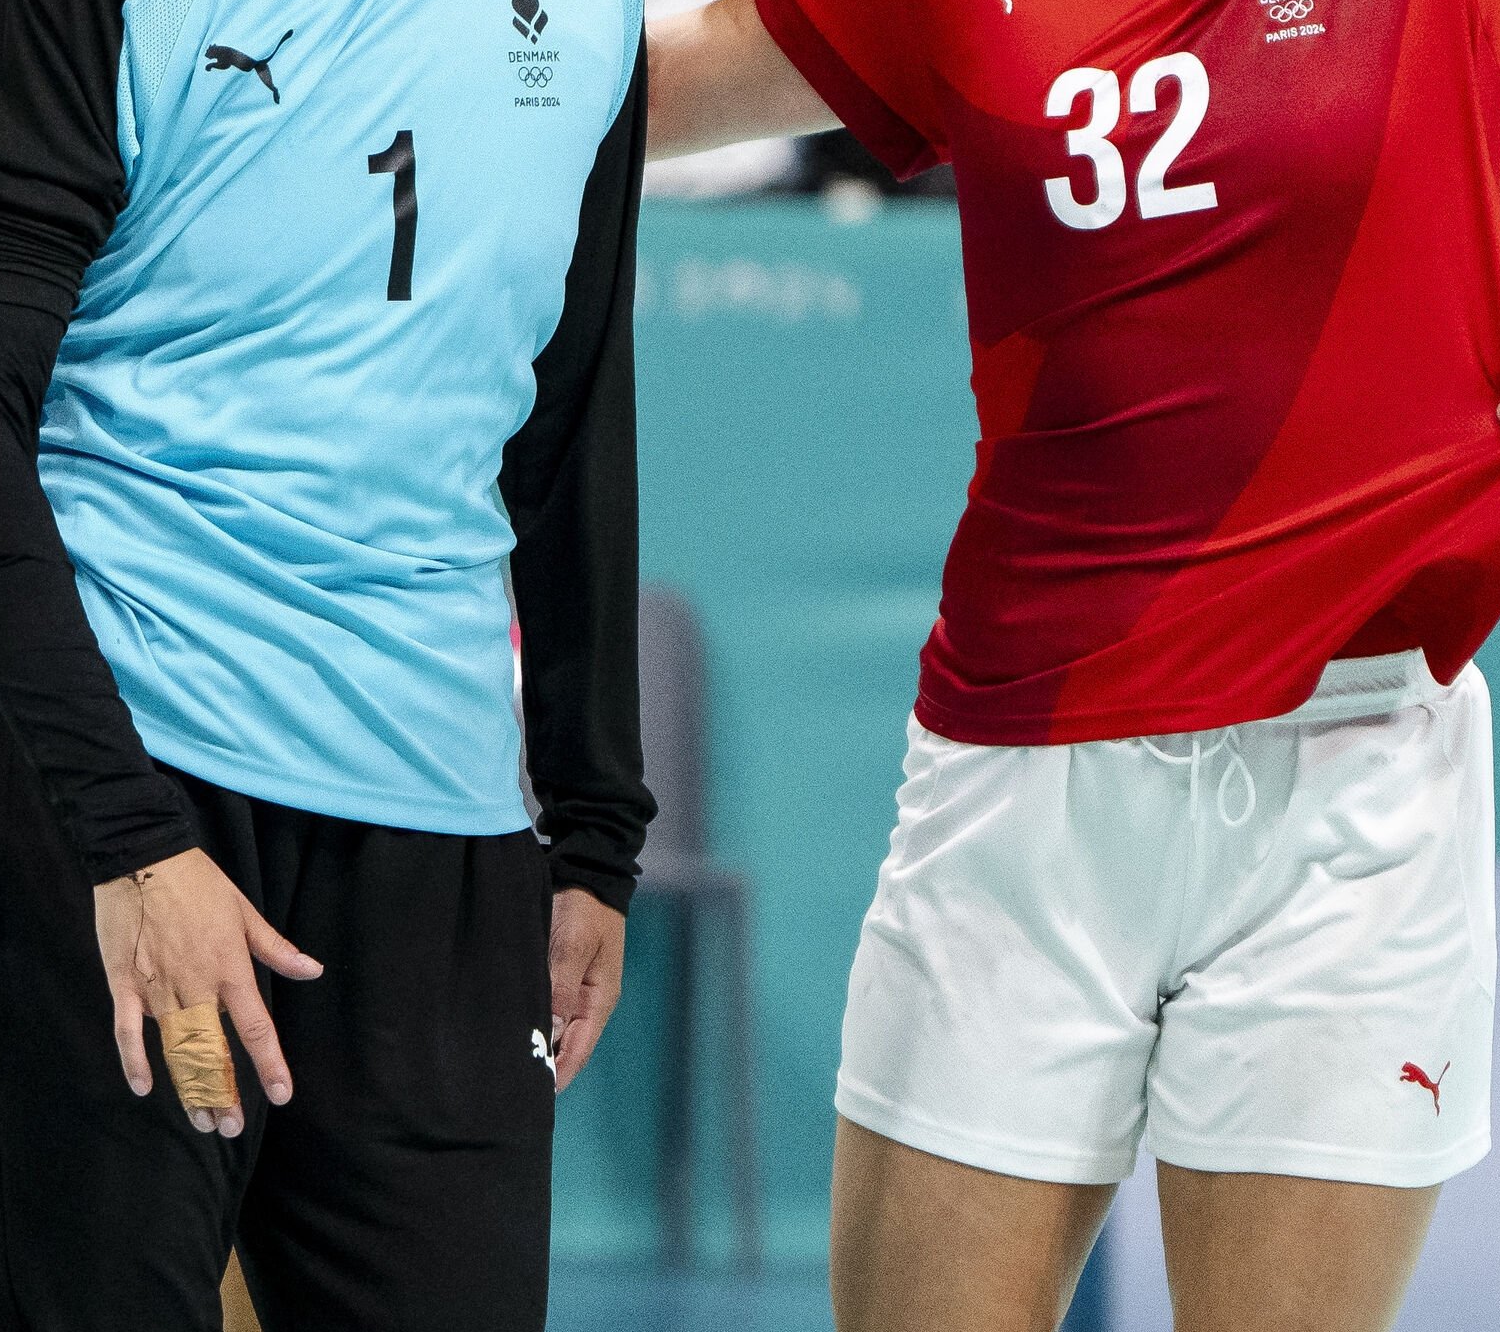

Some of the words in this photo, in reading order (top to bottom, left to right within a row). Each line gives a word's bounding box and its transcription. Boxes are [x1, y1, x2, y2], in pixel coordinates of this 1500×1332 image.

[1265, 26, 1299, 44] PARIS
[1300, 23, 1326, 37] 2024
[508, 50, 561, 63] DENMARK
[514, 96, 540, 108] PARIS
[541, 96, 561, 108] 2024
[1045, 52, 1218, 230] 32
[367, 129, 419, 301] 1
